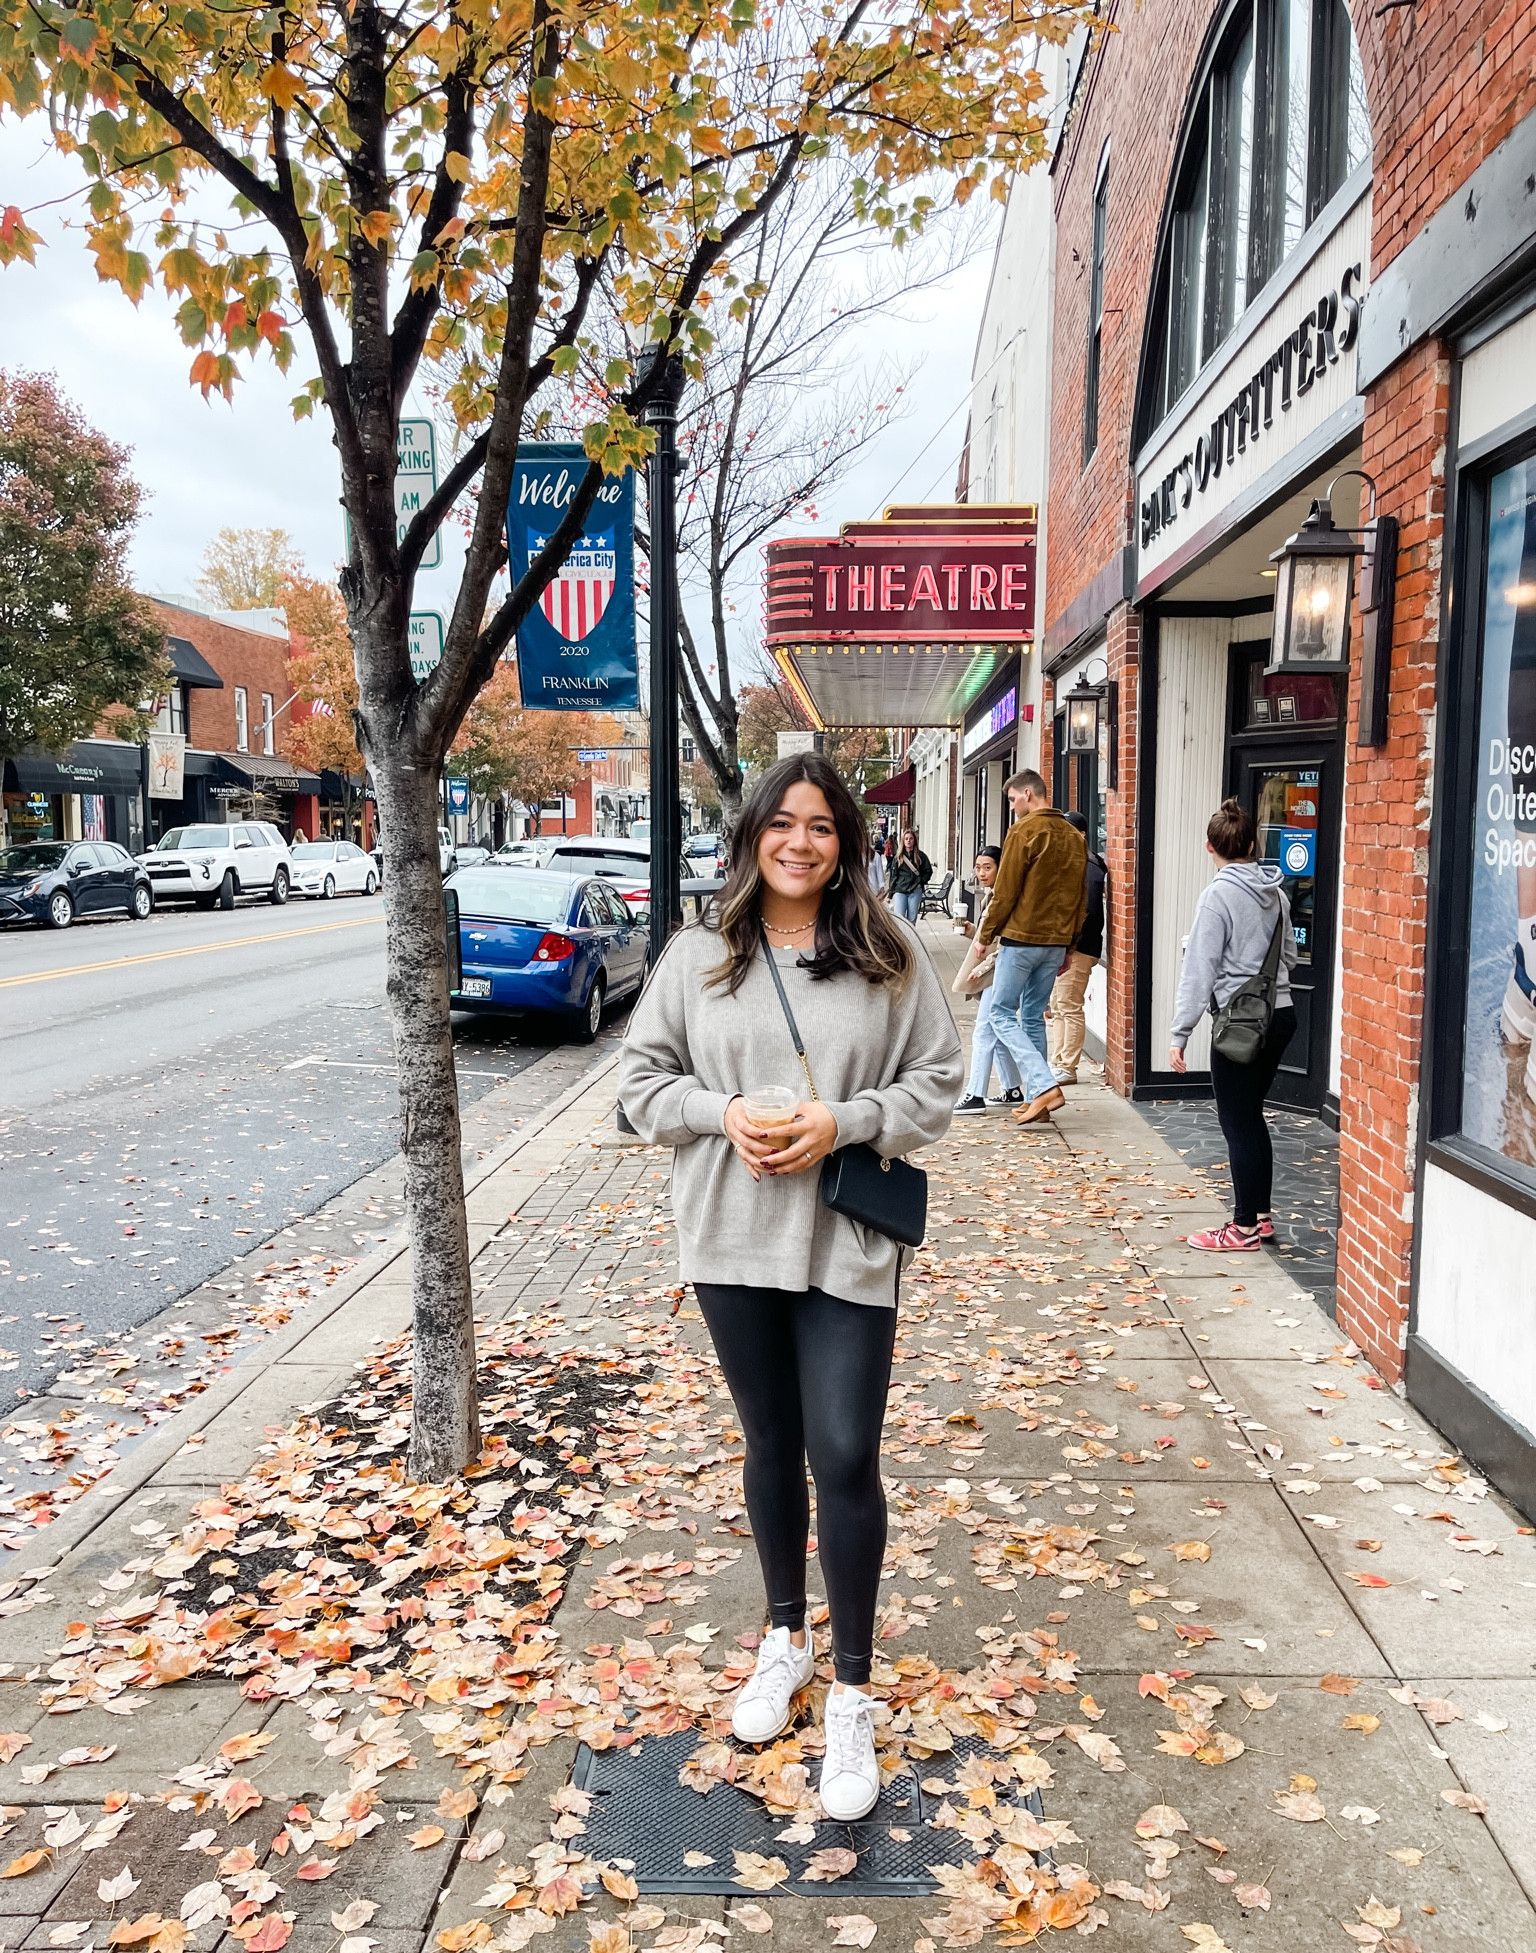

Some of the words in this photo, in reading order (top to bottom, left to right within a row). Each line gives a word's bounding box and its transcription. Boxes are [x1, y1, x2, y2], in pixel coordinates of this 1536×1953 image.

[1195, 262, 1362, 493] OUTFITTERS
[519, 469, 623, 509] Welcme
[401, 492, 420, 511] AM
[594, 552, 614, 569] City
[818, 564, 1027, 612] THEATRE
[559, 646, 590, 656] 2020
[542, 676, 609, 690] FRANKLIN
[557, 697, 603, 706] TENNESSEE
[1489, 738, 1536, 775] Disc
[1298, 771, 1319, 780] YETI
